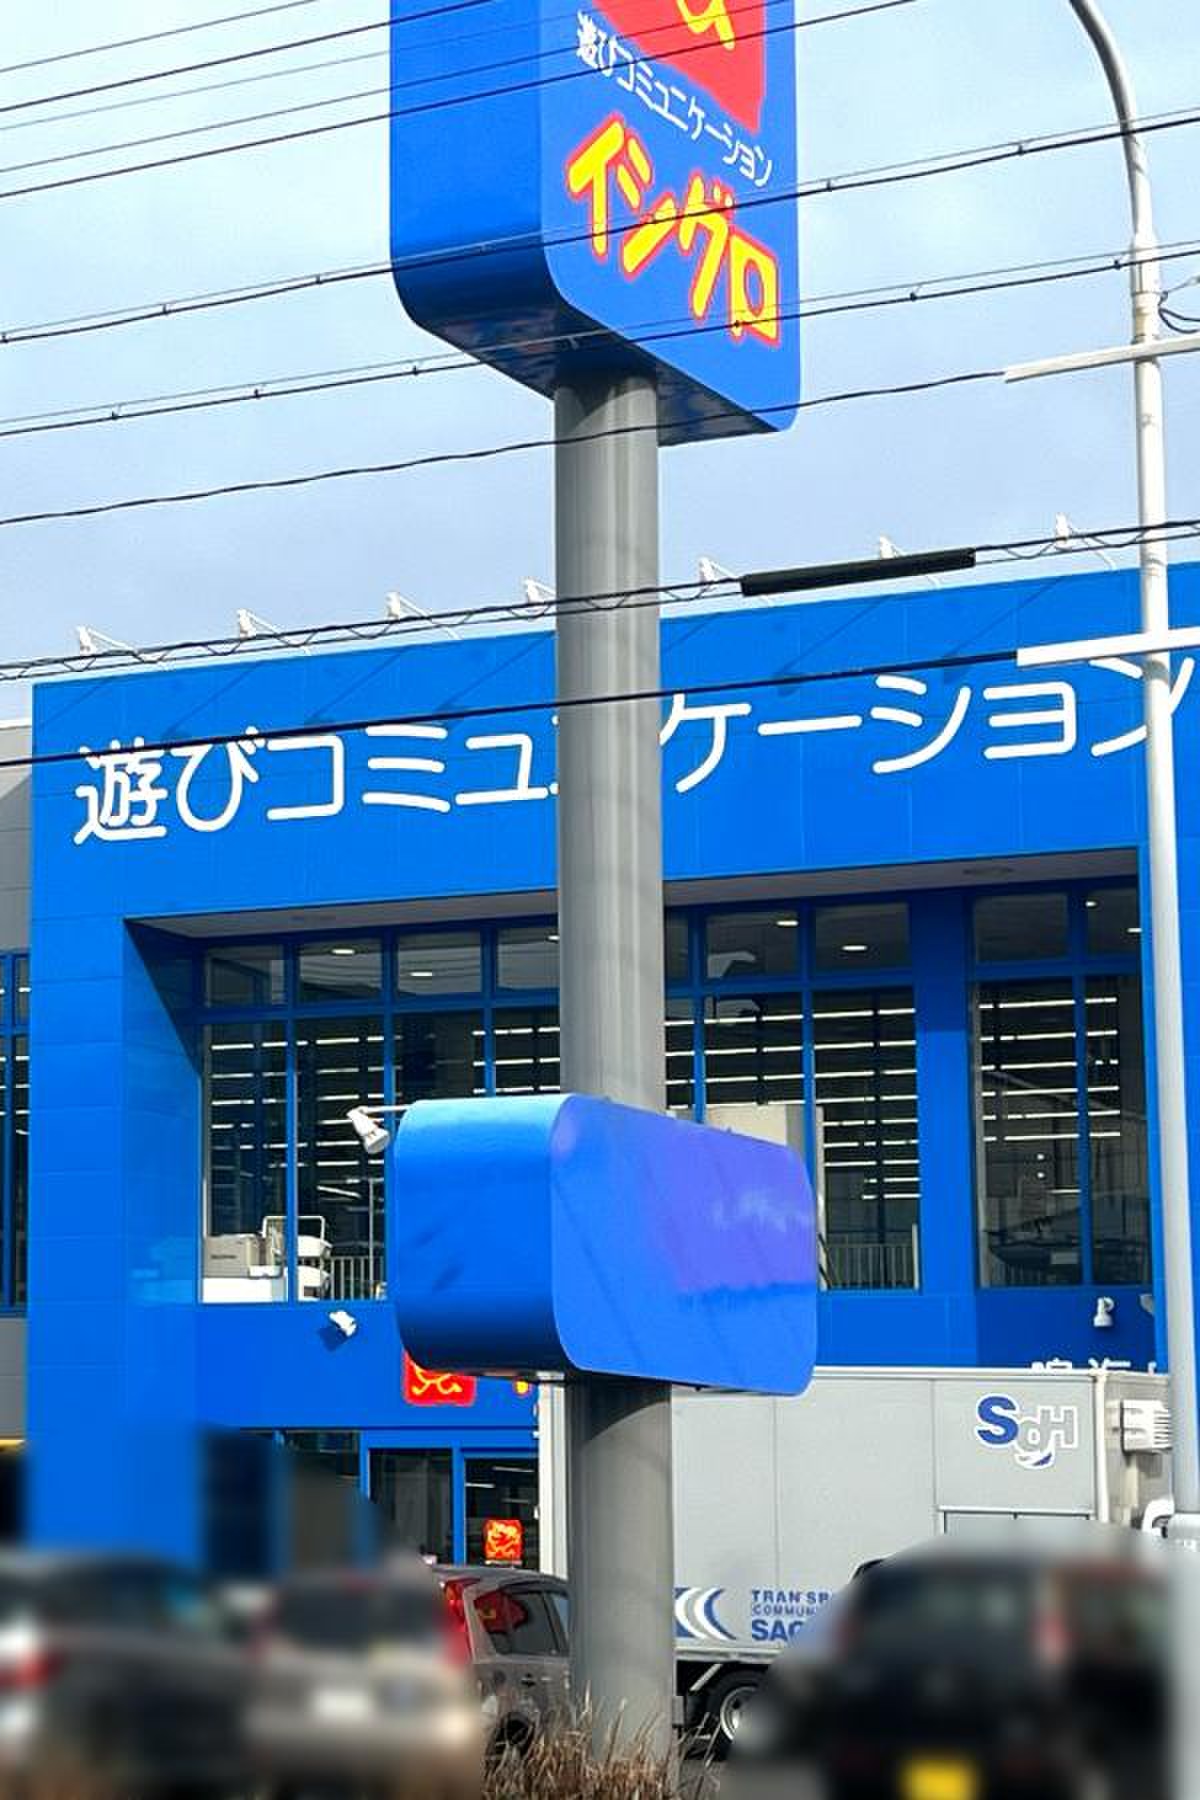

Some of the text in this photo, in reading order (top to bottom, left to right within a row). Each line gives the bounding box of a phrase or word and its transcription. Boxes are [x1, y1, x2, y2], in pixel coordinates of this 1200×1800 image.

[576, 10, 773, 187] 遊びコミュニケーション
[566, 113, 781, 347] イシグロ
[73, 657, 1195, 845] 遊びコミュケーション
